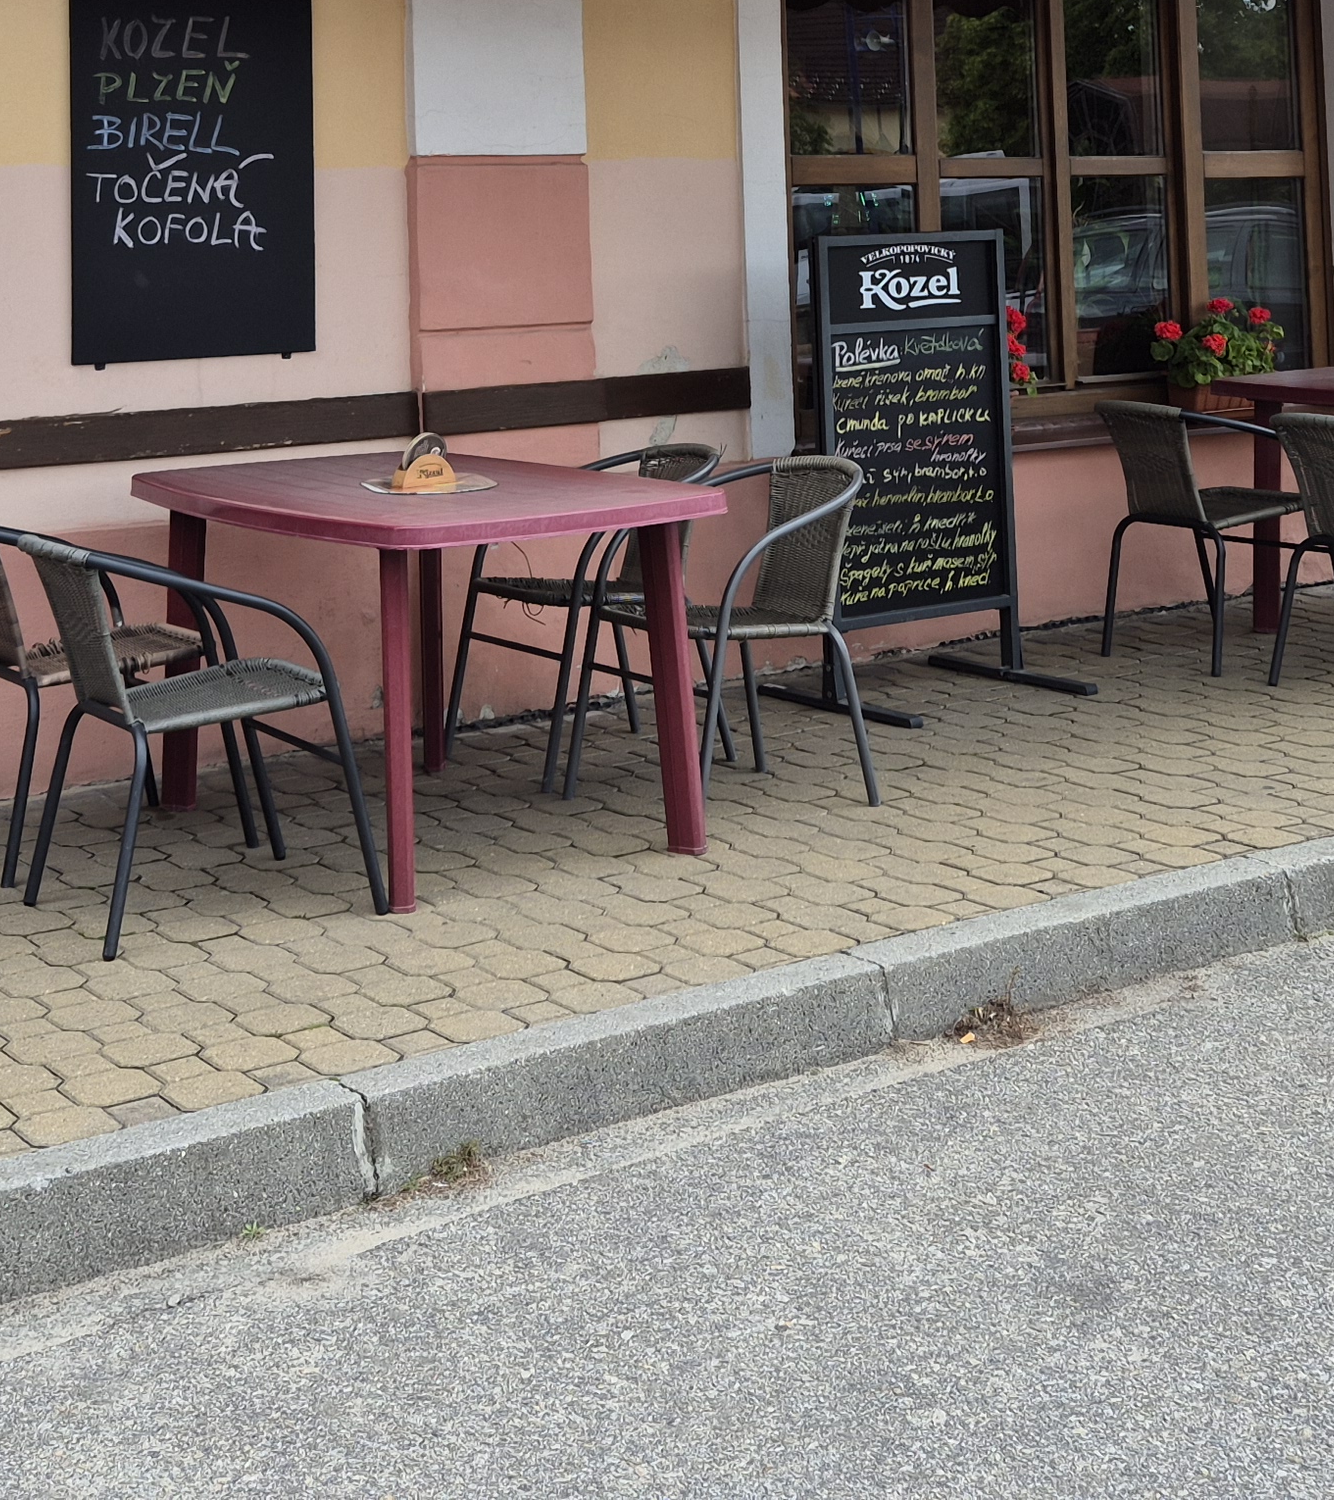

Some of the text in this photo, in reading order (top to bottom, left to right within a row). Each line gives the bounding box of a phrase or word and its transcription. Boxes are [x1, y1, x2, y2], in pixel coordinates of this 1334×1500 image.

[99, 16, 250, 61] KOZEL
[93, 60, 240, 104] PLZEŇ
[86, 111, 240, 156] BIRELL
[86, 152, 274, 208] TOČENÁ
[114, 207, 267, 251] KOFOLA
[860, 244, 956, 266] VELKOPOPOVICKÝ
[859, 267, 961, 311] Kozel
[898, 413, 914, 438] po
[875, 441, 902, 456] prsa
[894, 563, 904, 577] s
